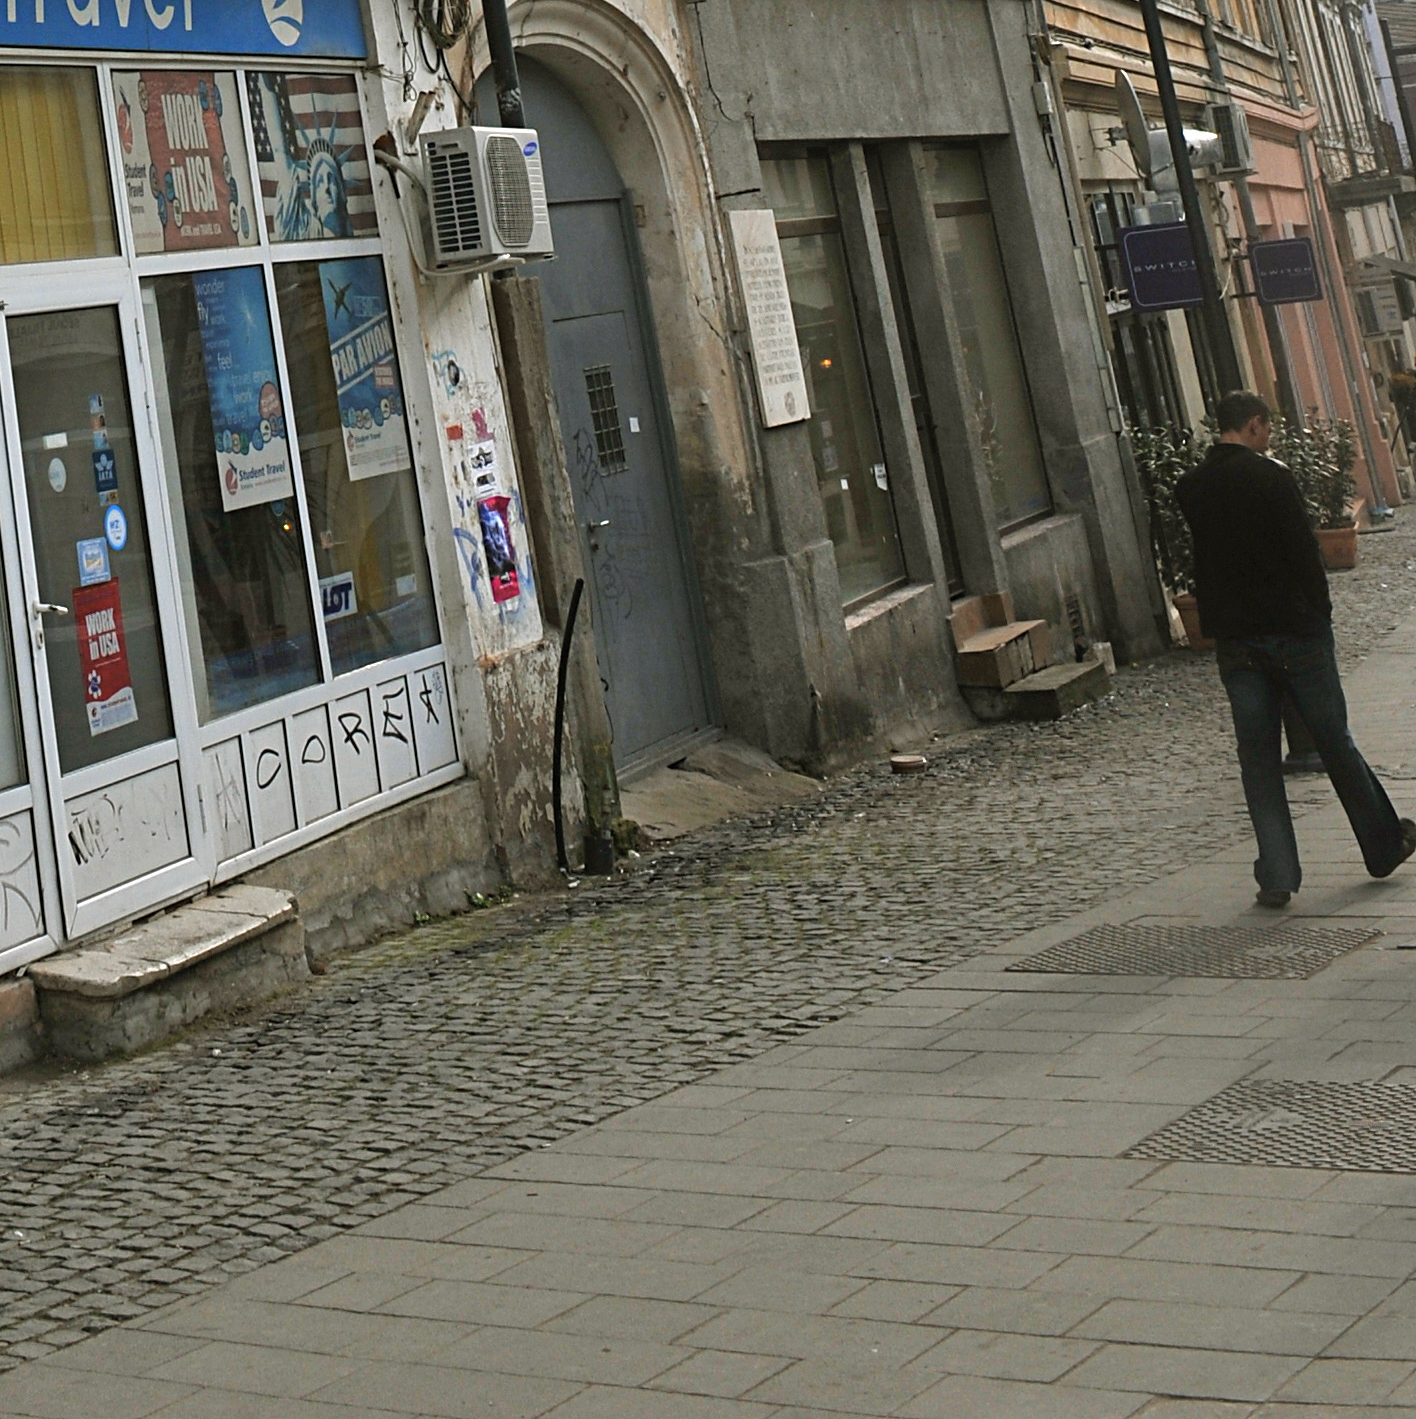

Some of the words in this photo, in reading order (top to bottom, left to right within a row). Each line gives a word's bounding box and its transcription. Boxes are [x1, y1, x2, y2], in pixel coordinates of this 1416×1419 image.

[161, 94, 209, 151] WORK
[169, 157, 191, 213] in
[186, 156, 219, 213] USA
[331, 349, 358, 385] PAR
[356, 321, 393, 368] AVION
[239, 466, 266, 482] Student
[267, 461, 286, 478] Travel
[85, 608, 117, 637] WORK
[88, 639, 100, 661] in
[99, 631, 121, 658] USA
